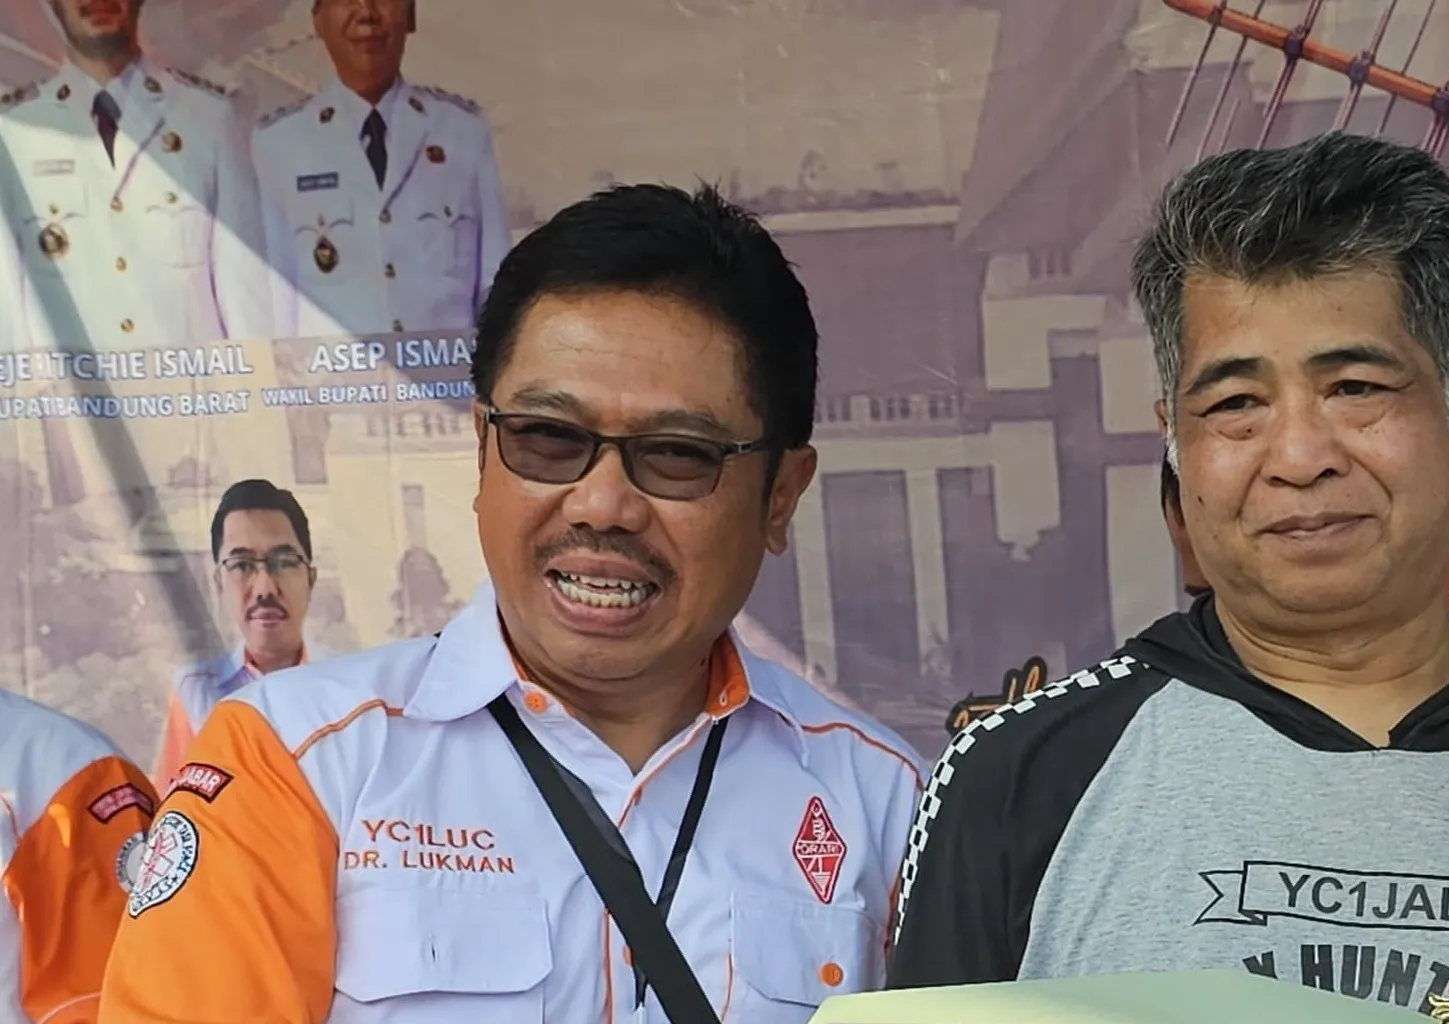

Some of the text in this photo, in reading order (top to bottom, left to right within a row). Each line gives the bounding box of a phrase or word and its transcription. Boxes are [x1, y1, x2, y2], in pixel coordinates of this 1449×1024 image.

[34, 351, 147, 381] ITCHIE
[154, 345, 254, 379] ISMAIL
[309, 338, 477, 374] ASEP ISMA
[179, 391, 251, 415] BARAT
[261, 388, 314, 407] WAKIL
[319, 384, 387, 403] BUPATI
[343, 850, 516, 874] DR. LUKMAN
